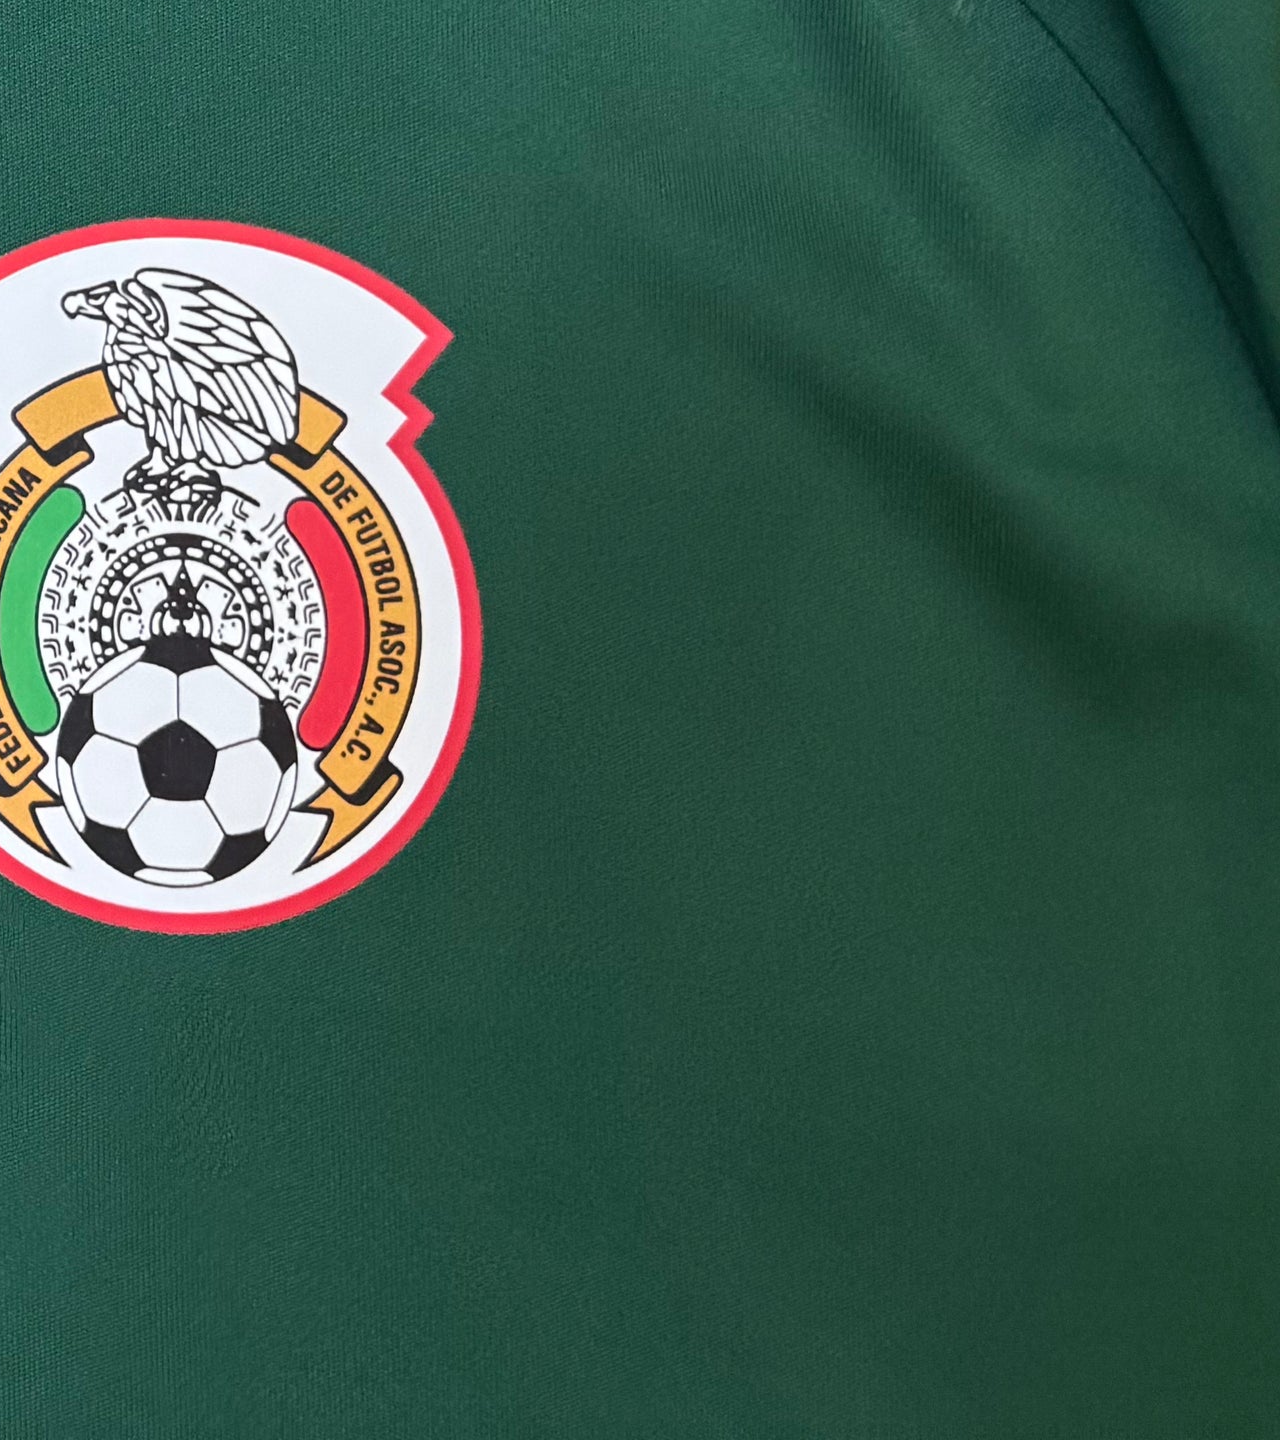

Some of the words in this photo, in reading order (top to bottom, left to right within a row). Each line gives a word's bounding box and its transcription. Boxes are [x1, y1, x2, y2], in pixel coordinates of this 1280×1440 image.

[319, 470, 359, 511] DE
[347, 506, 403, 612] FUTBOL
[340, 712, 385, 762] A.C.
